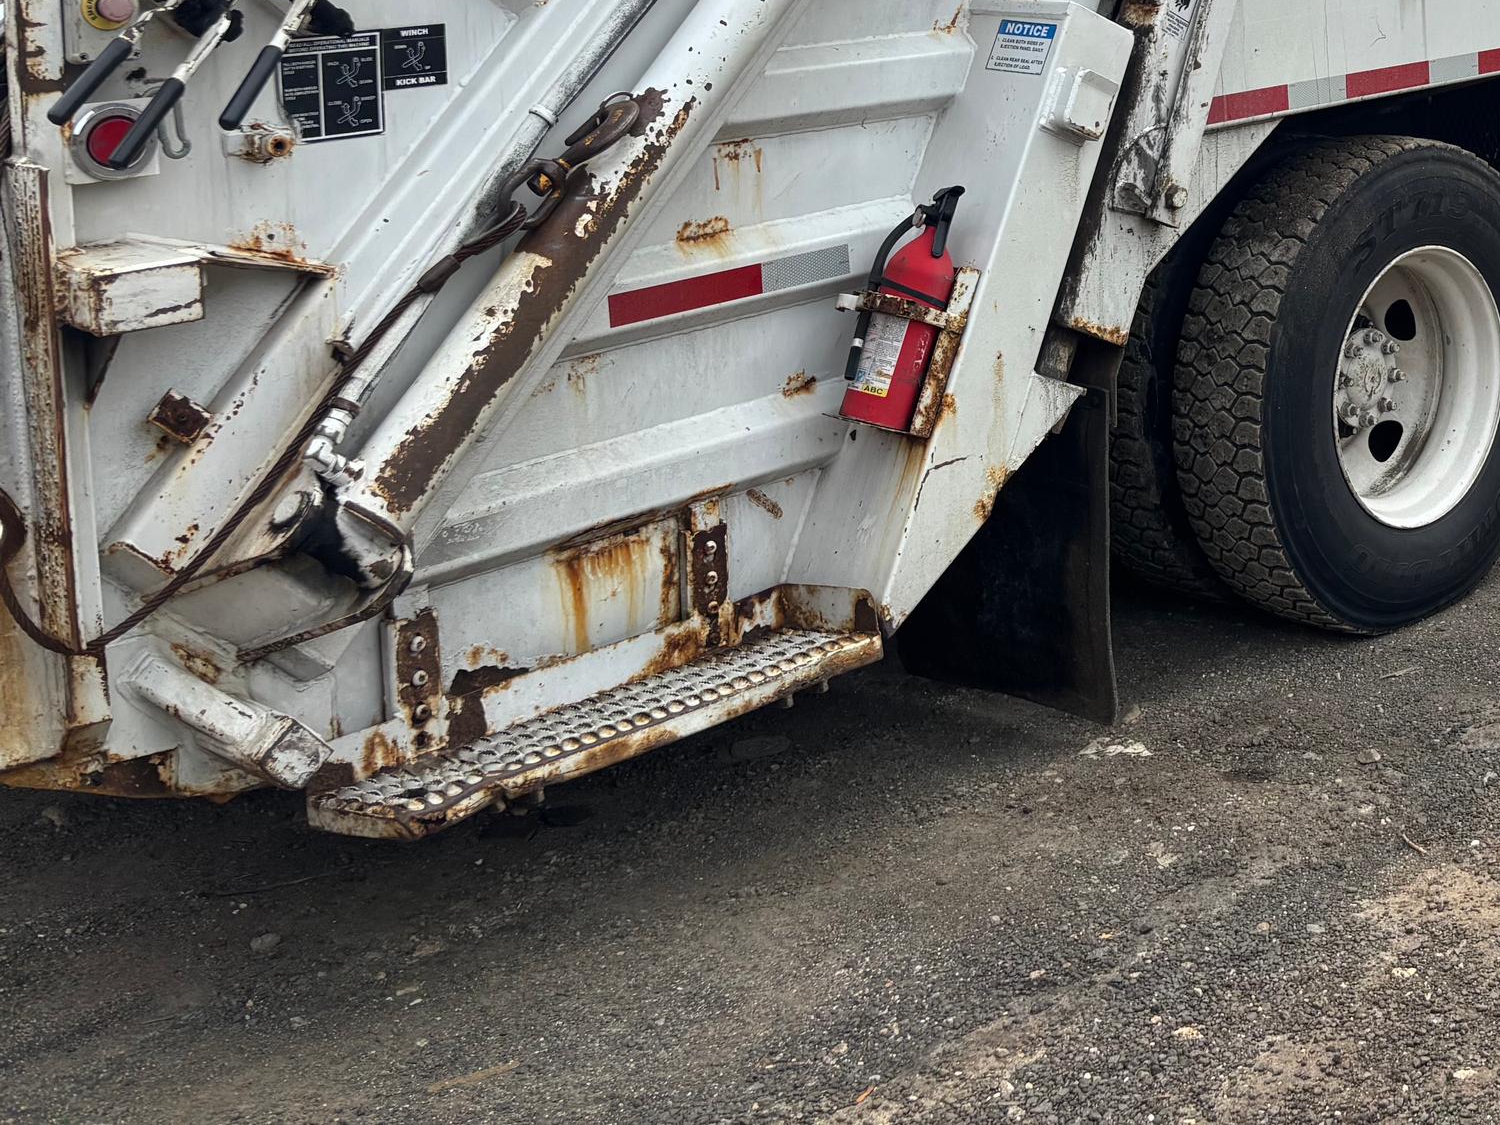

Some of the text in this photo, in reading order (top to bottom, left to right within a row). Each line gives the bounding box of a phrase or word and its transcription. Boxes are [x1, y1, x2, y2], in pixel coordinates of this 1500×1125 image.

[400, 28, 429, 36] WINCH
[1005, 22, 1049, 36] NOTICE
[396, 78, 417, 86] KICK
[864, 386, 883, 395] ABC
